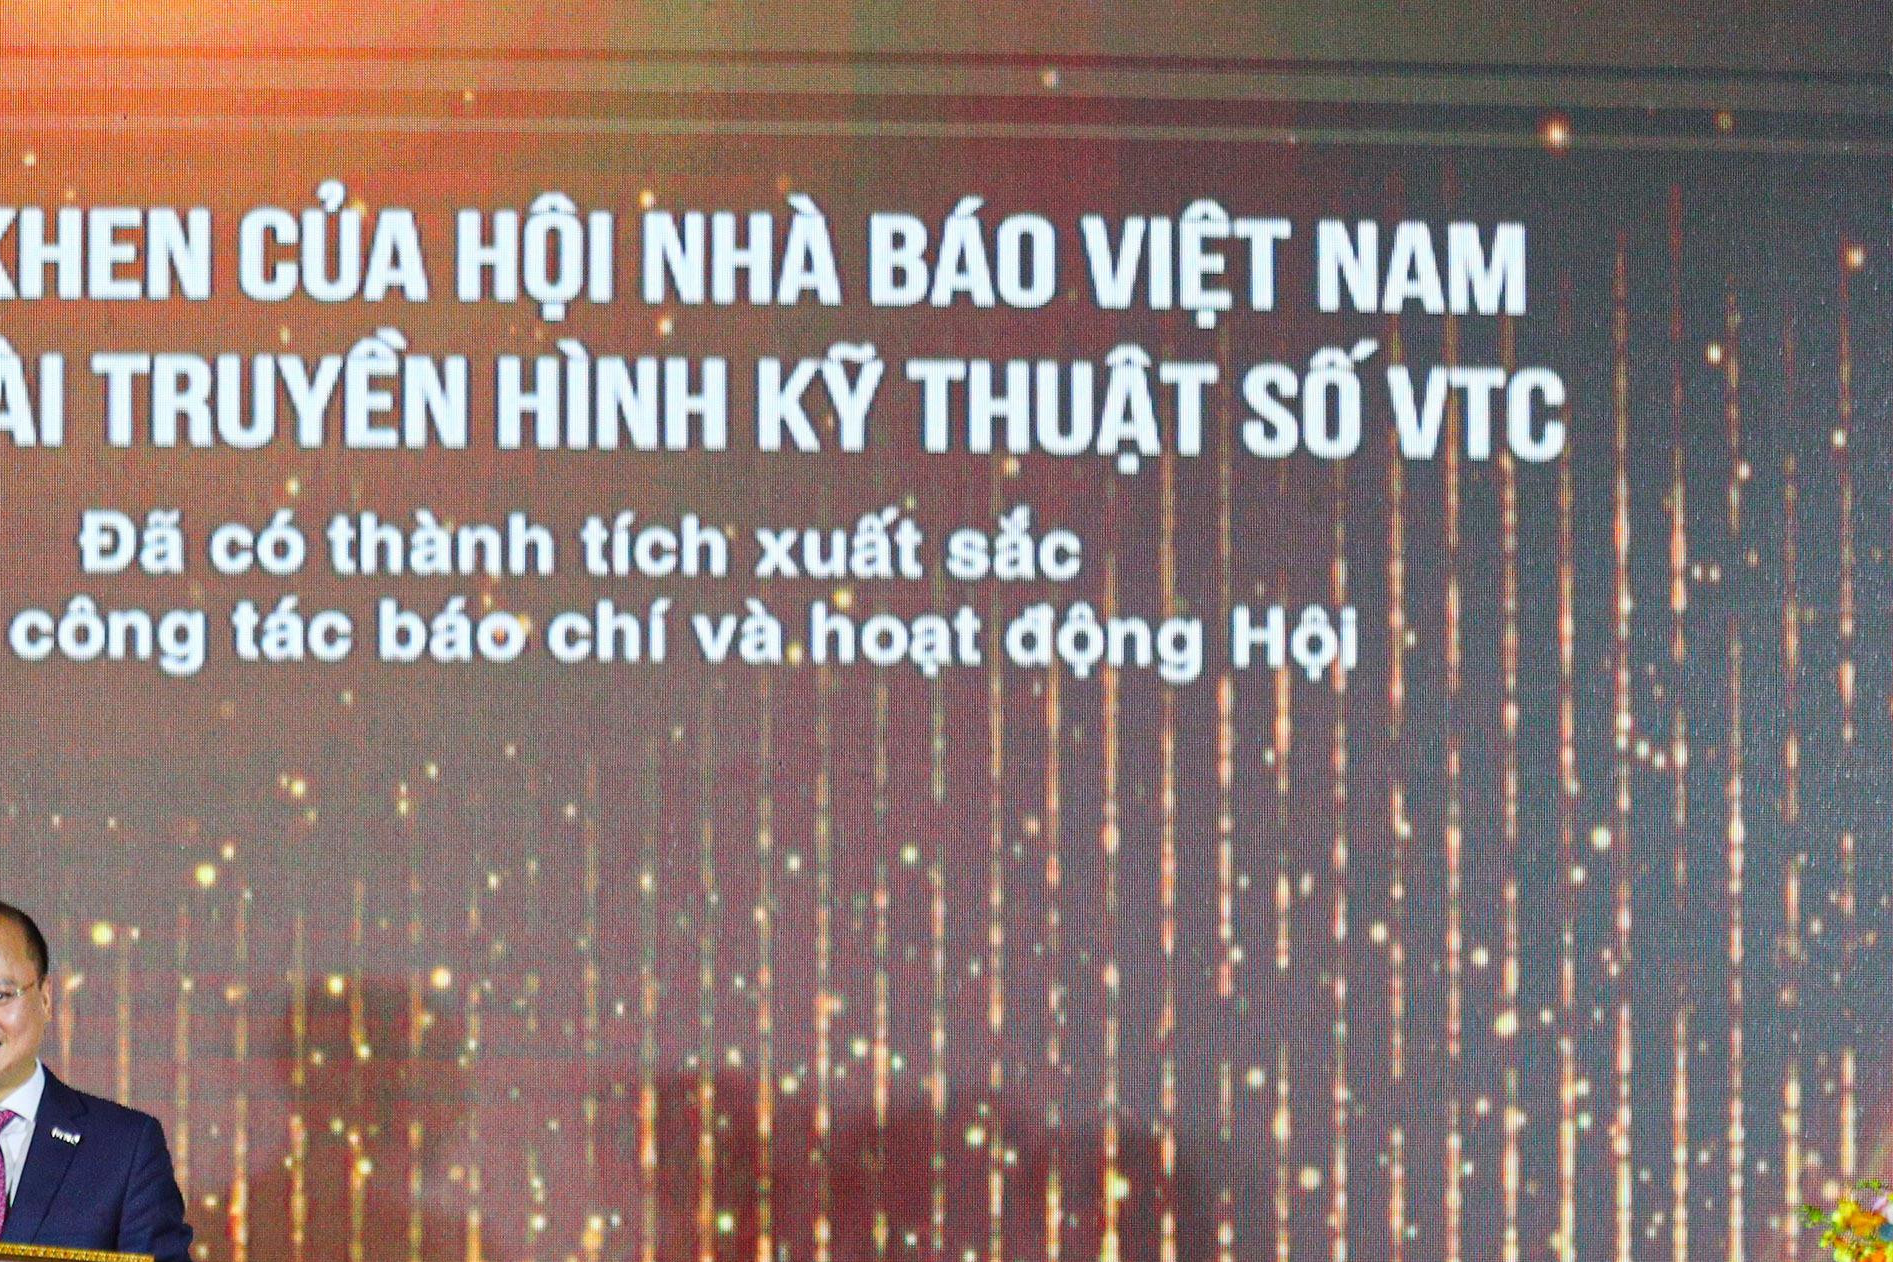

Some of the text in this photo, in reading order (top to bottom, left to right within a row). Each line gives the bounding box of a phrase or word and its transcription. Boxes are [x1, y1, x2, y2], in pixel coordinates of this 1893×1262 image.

[238, 178, 429, 303] CỦA
[456, 191, 613, 322] HỘI
[642, 193, 842, 306] NHÀ
[869, 195, 1057, 308] BÁO
[1081, 199, 1293, 330] VIỆT
[1317, 220, 1527, 316] NAM
[90, 326, 468, 450] TRUYỀN
[496, 337, 729, 451] HÌNH
[756, 342, 886, 453] KỸ
[905, 344, 1220, 475] THUẬT
[1242, 339, 1379, 461] SỐ
[1387, 364, 1567, 462] VTC
[78, 503, 1083, 581] Đã có thành tích xuất sắc
[9, 594, 206, 677] công
[231, 594, 353, 662] tác
[379, 595, 526, 663] báo
[547, 596, 671, 664] chí
[692, 597, 783, 665] và
[811, 600, 982, 678] hoạt
[1005, 601, 1203, 684] động
[1232, 603, 1359, 682] Hội
